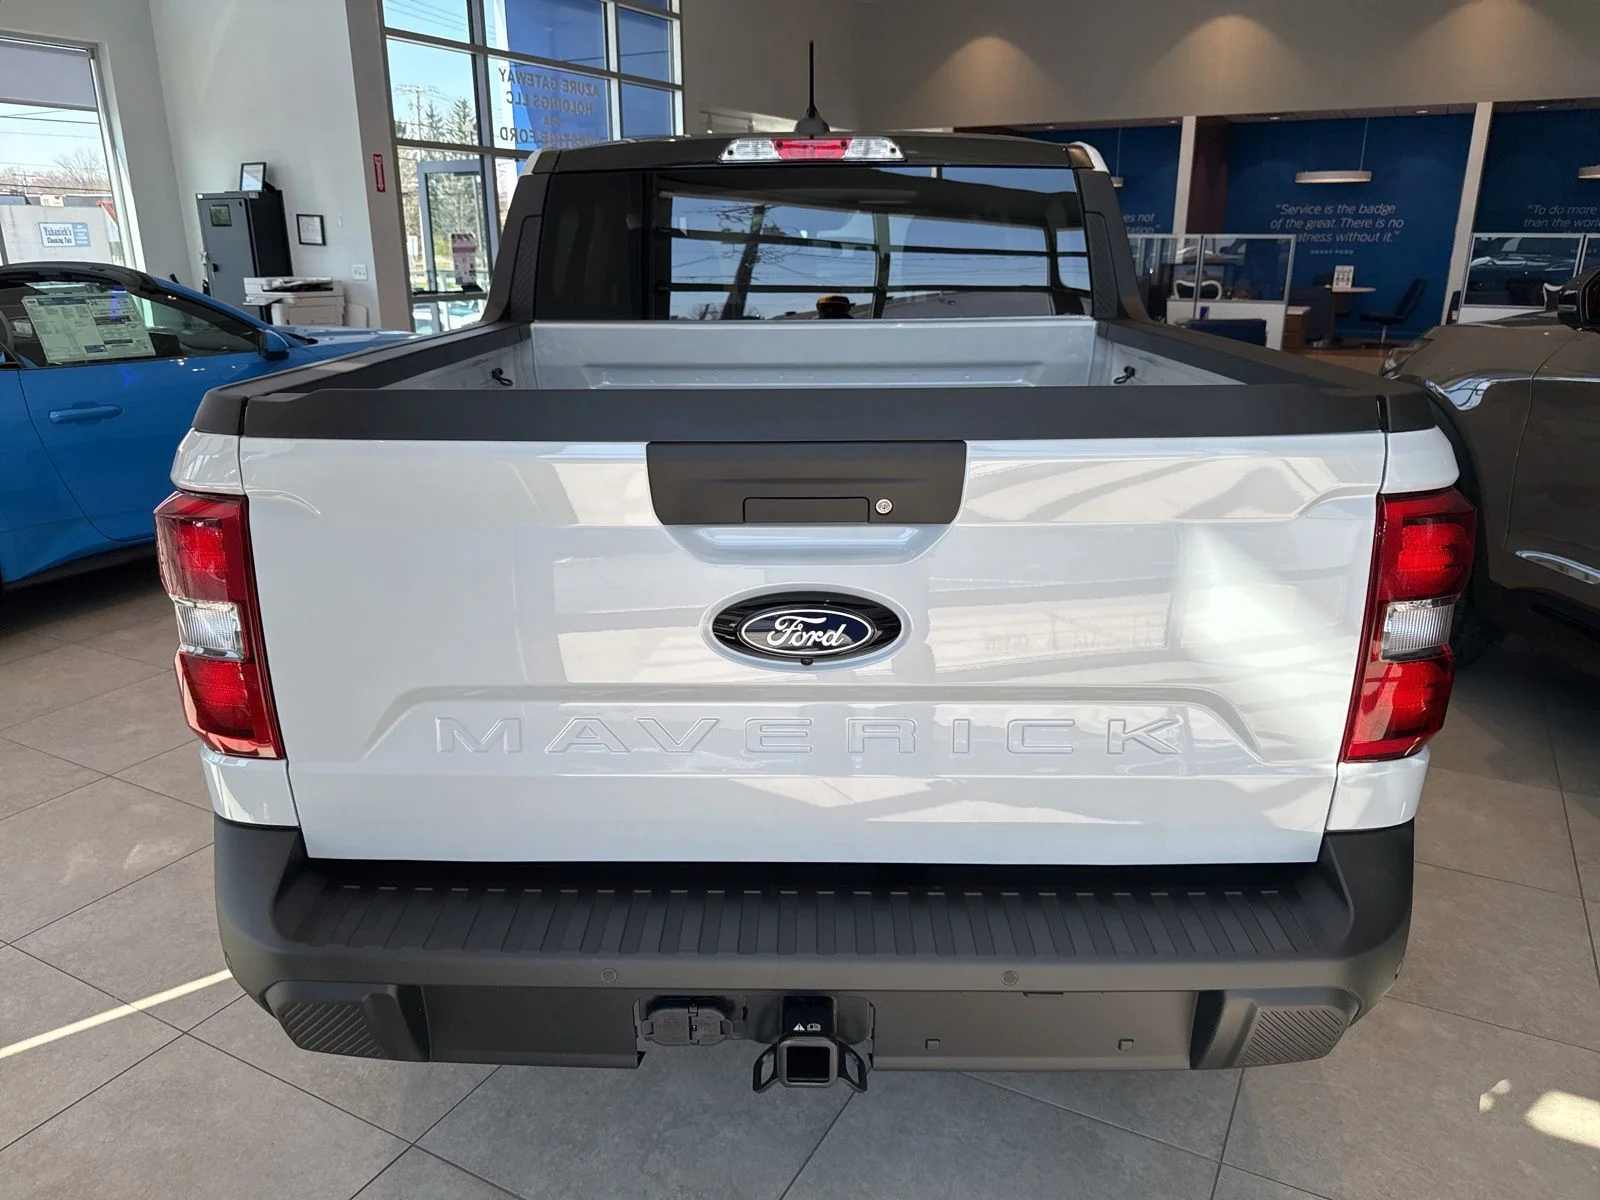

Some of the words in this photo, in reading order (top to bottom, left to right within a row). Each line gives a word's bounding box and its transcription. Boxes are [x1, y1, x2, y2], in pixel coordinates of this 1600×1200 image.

[1323, 204, 1334, 215] is
[1336, 204, 1357, 215] the
[1358, 203, 1396, 217] badge
[1549, 205, 1564, 215] do
[1567, 207, 1598, 215] more
[1137, 212, 1156, 222] not
[1523, 218, 1549, 228] than
[1552, 218, 1571, 228] the
[1270, 218, 1283, 230] of
[1284, 218, 1304, 229] the
[1304, 218, 1338, 230] great.
[1340, 217, 1373, 229] There
[1374, 218, 1386, 229] is
[1388, 218, 1405, 229] no
[1335, 231, 1381, 243] without
[767, 615, 847, 647] Ford
[434, 716, 1182, 755] MAVERICK
